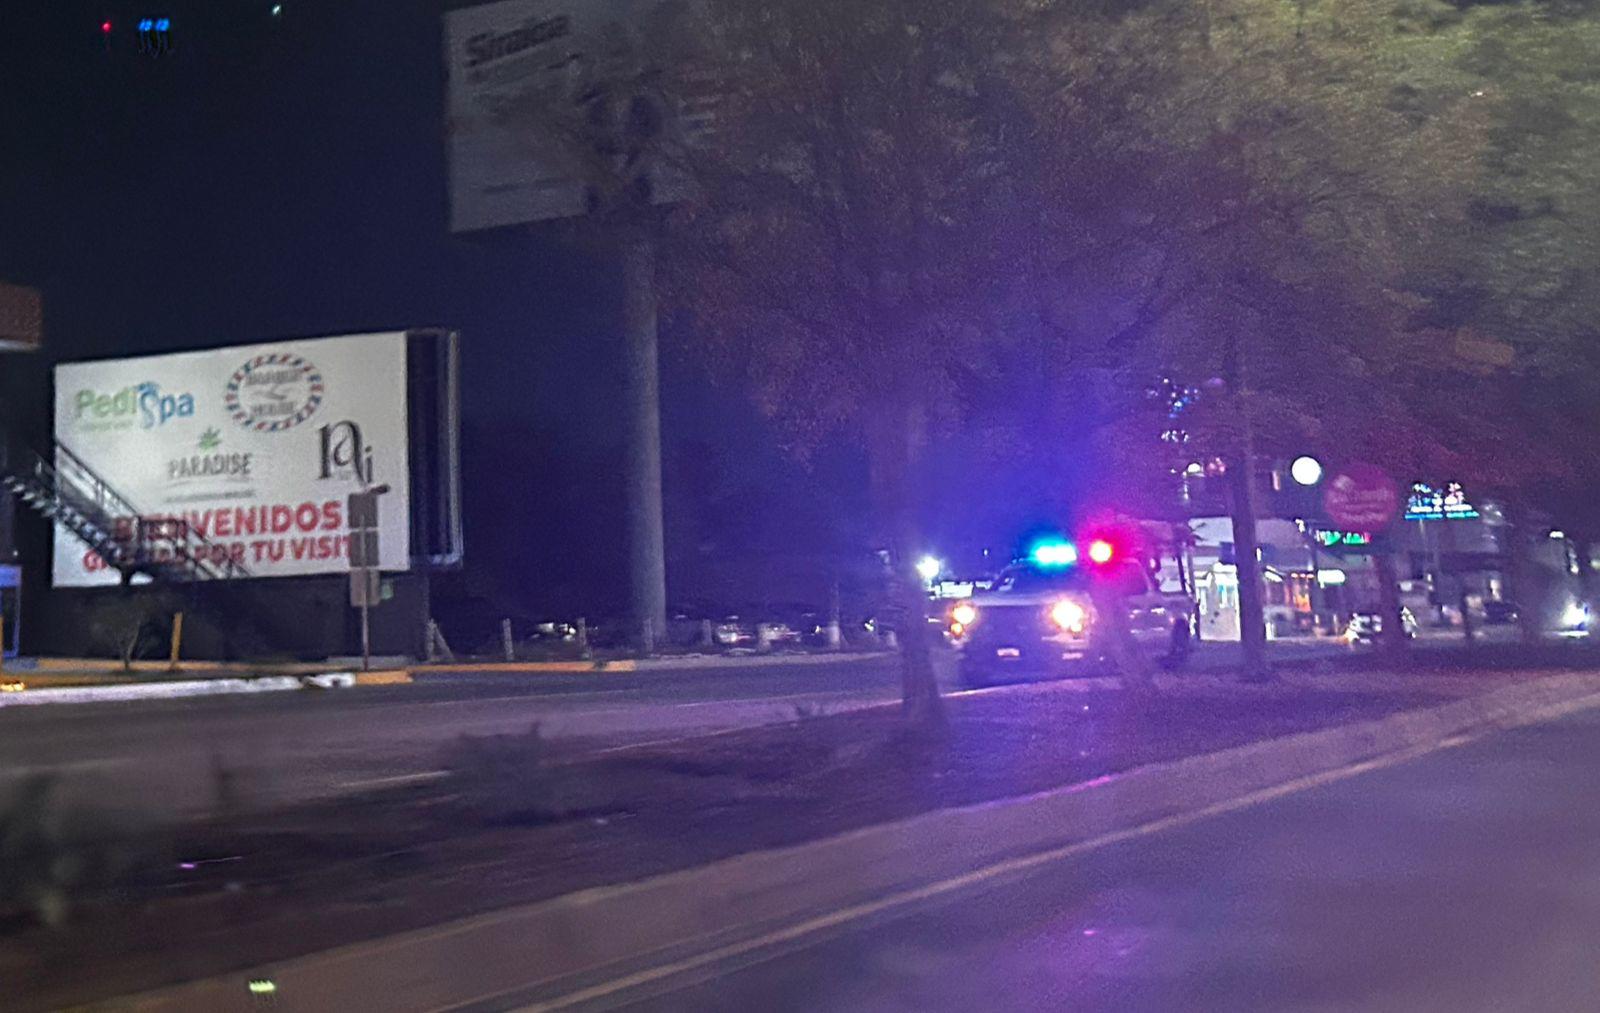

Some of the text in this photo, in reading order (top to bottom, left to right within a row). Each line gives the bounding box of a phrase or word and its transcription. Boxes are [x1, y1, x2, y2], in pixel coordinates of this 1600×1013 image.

[169, 452, 253, 478] PARADISE
[113, 500, 342, 542] BENVENIDOS
[252, 538, 286, 563] TU
[290, 532, 353, 561] VISIT
